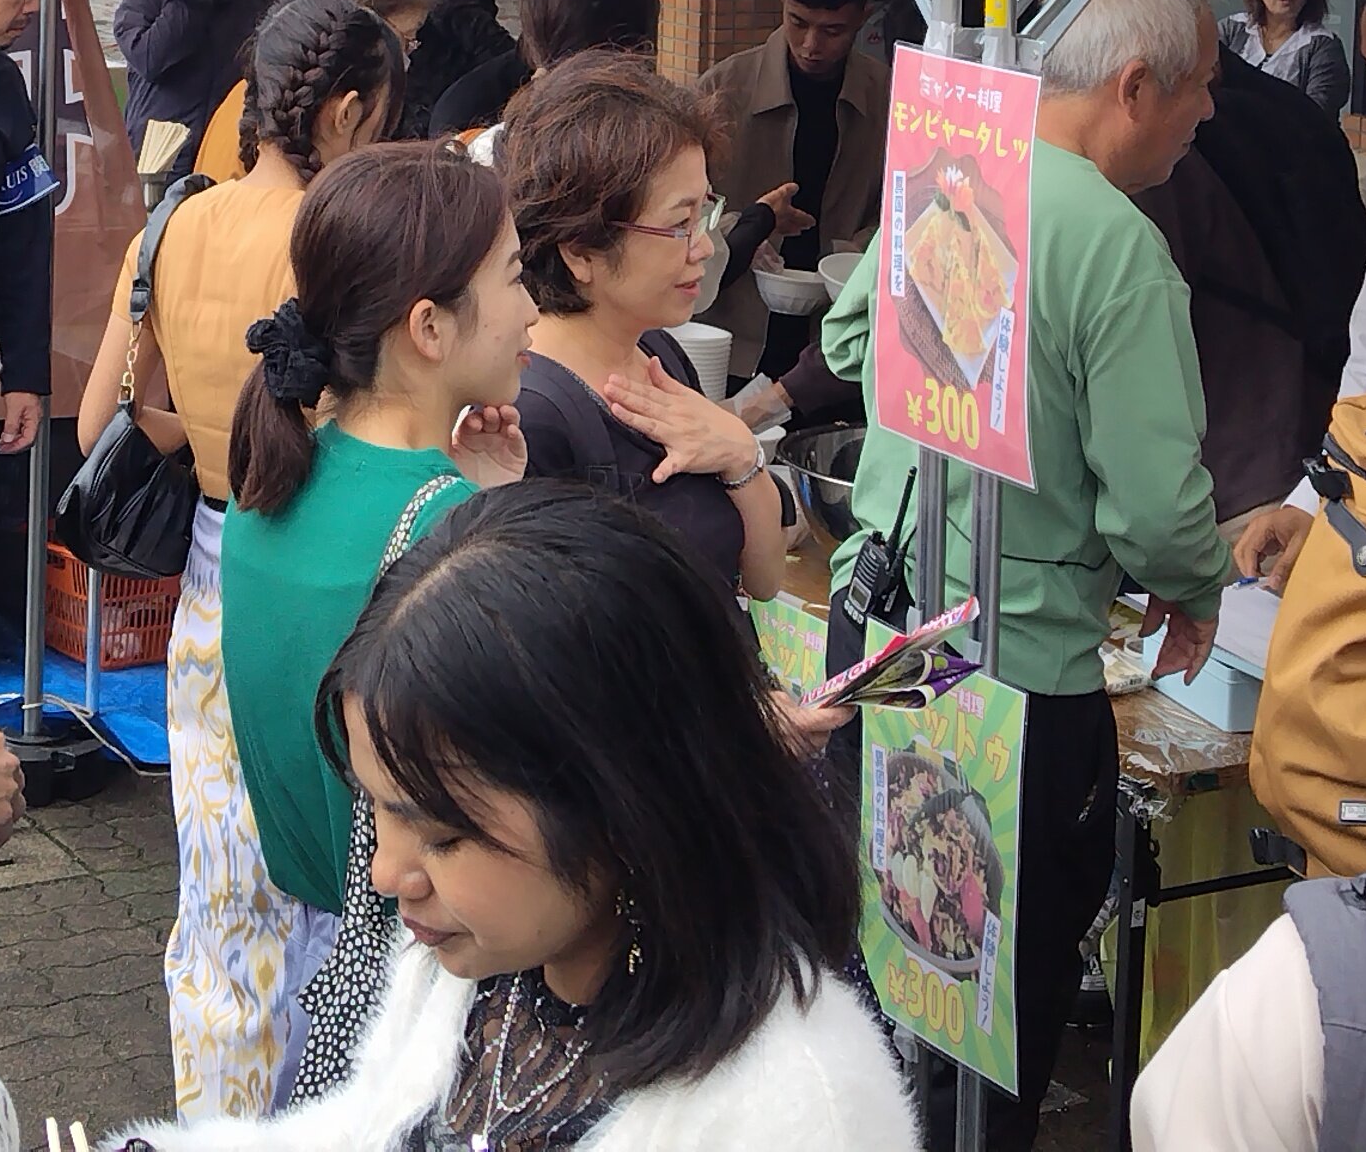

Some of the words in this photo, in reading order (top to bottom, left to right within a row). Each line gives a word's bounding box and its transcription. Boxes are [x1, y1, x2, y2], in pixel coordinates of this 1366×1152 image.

[919, 71, 1003, 114] ミャンマー料理
